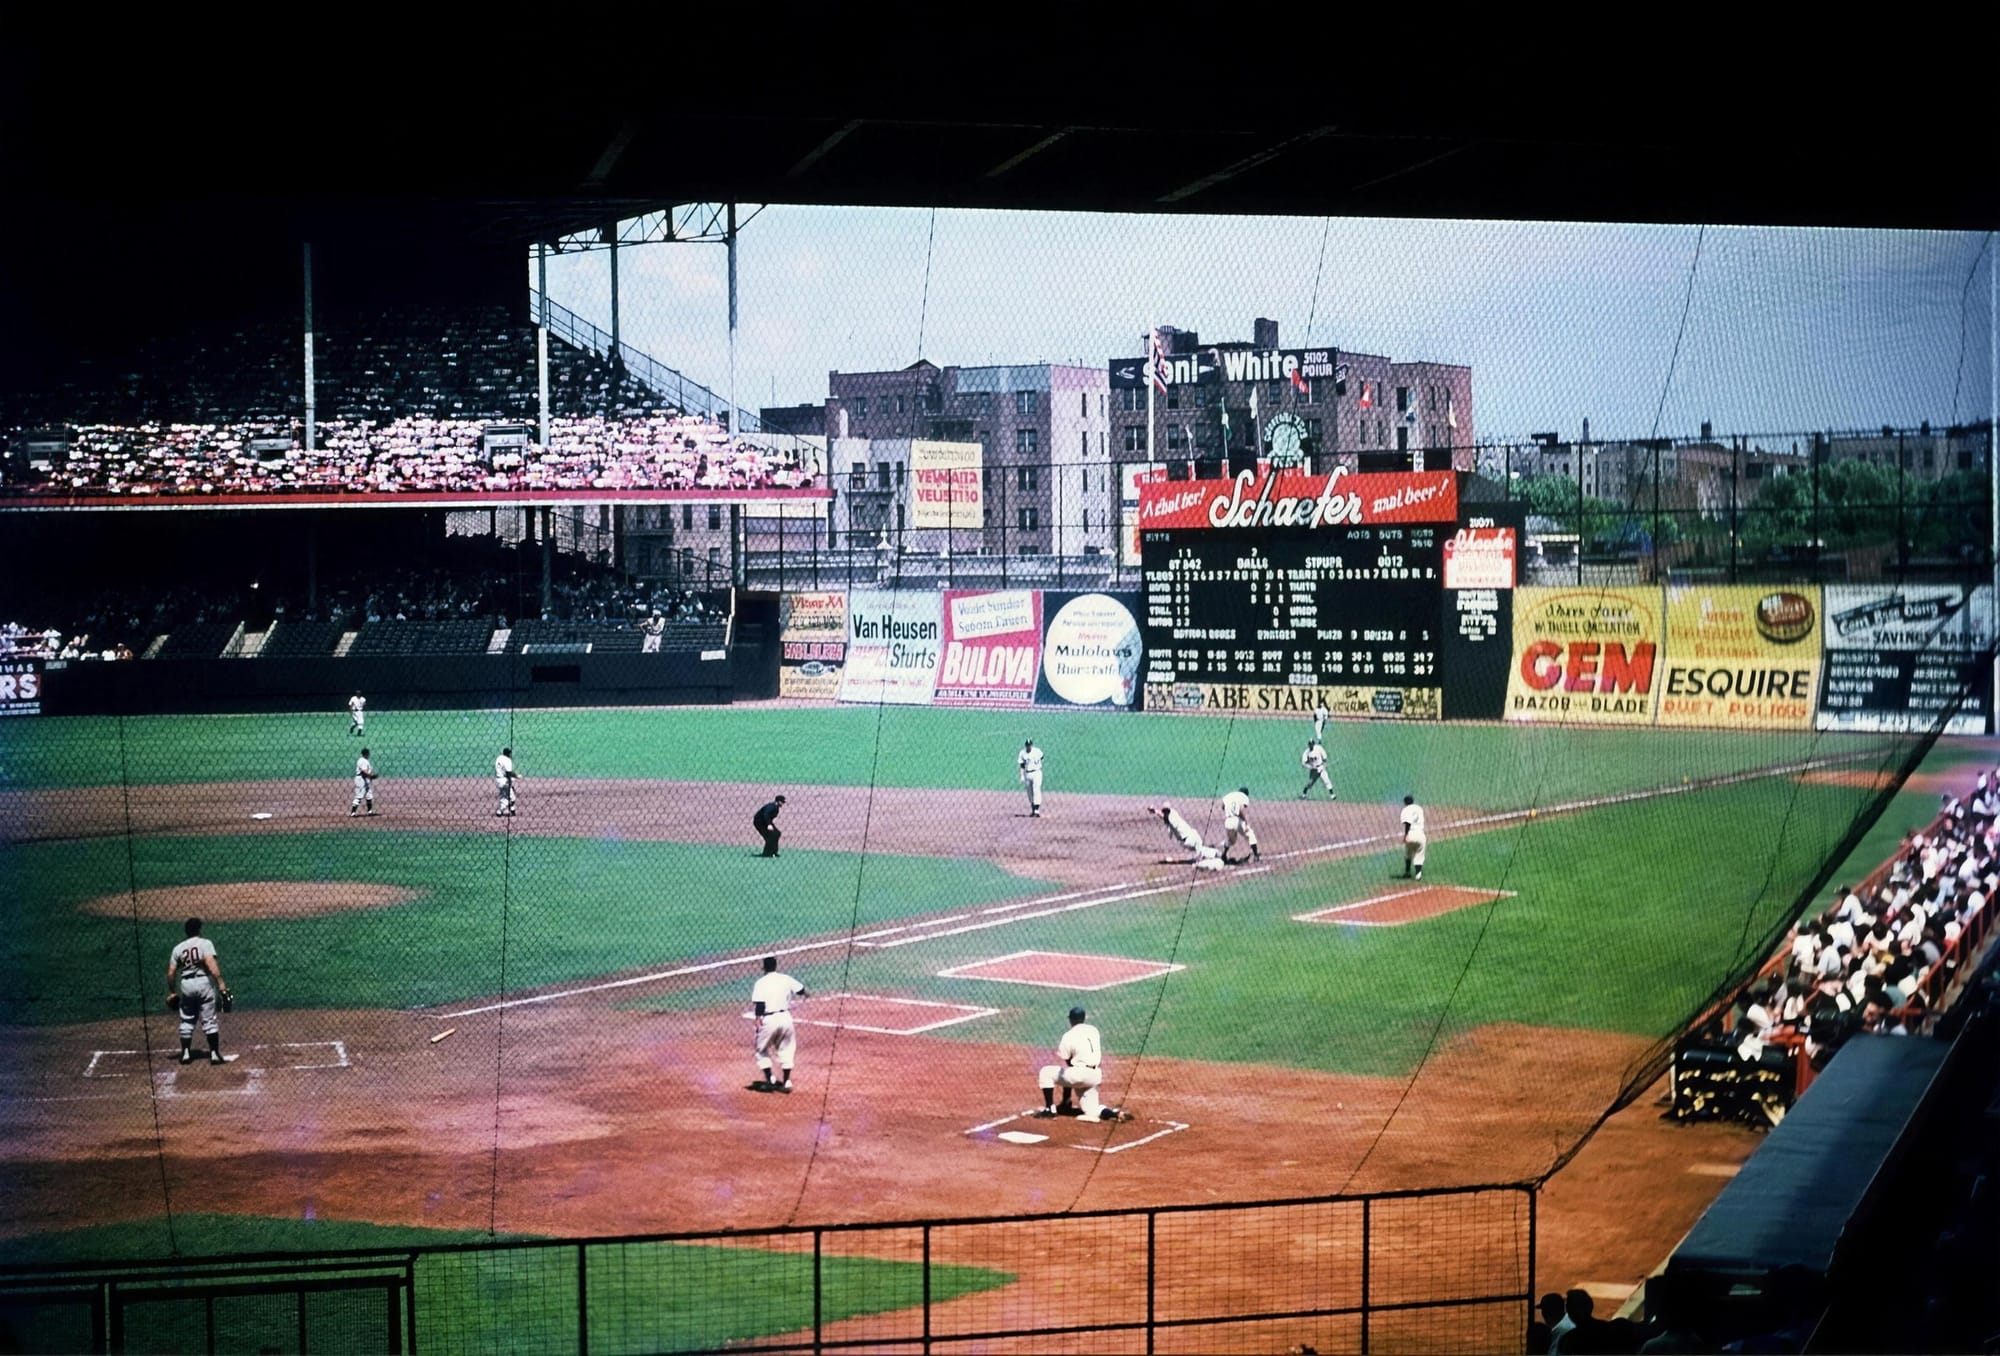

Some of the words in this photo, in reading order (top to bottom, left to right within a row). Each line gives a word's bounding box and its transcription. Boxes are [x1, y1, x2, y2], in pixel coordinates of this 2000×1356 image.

[1224, 351, 1299, 381] White
[1209, 466, 1363, 529] Schaefer
[853, 614, 879, 639] Van
[882, 614, 937, 640] Heusen
[1521, 640, 1656, 694] GEM
[1667, 667, 1810, 699] ESQUIRE
[1207, 687, 1250, 710] ABE
[1257, 688, 1331, 712] STARK
[182, 946, 200, 966] 20
